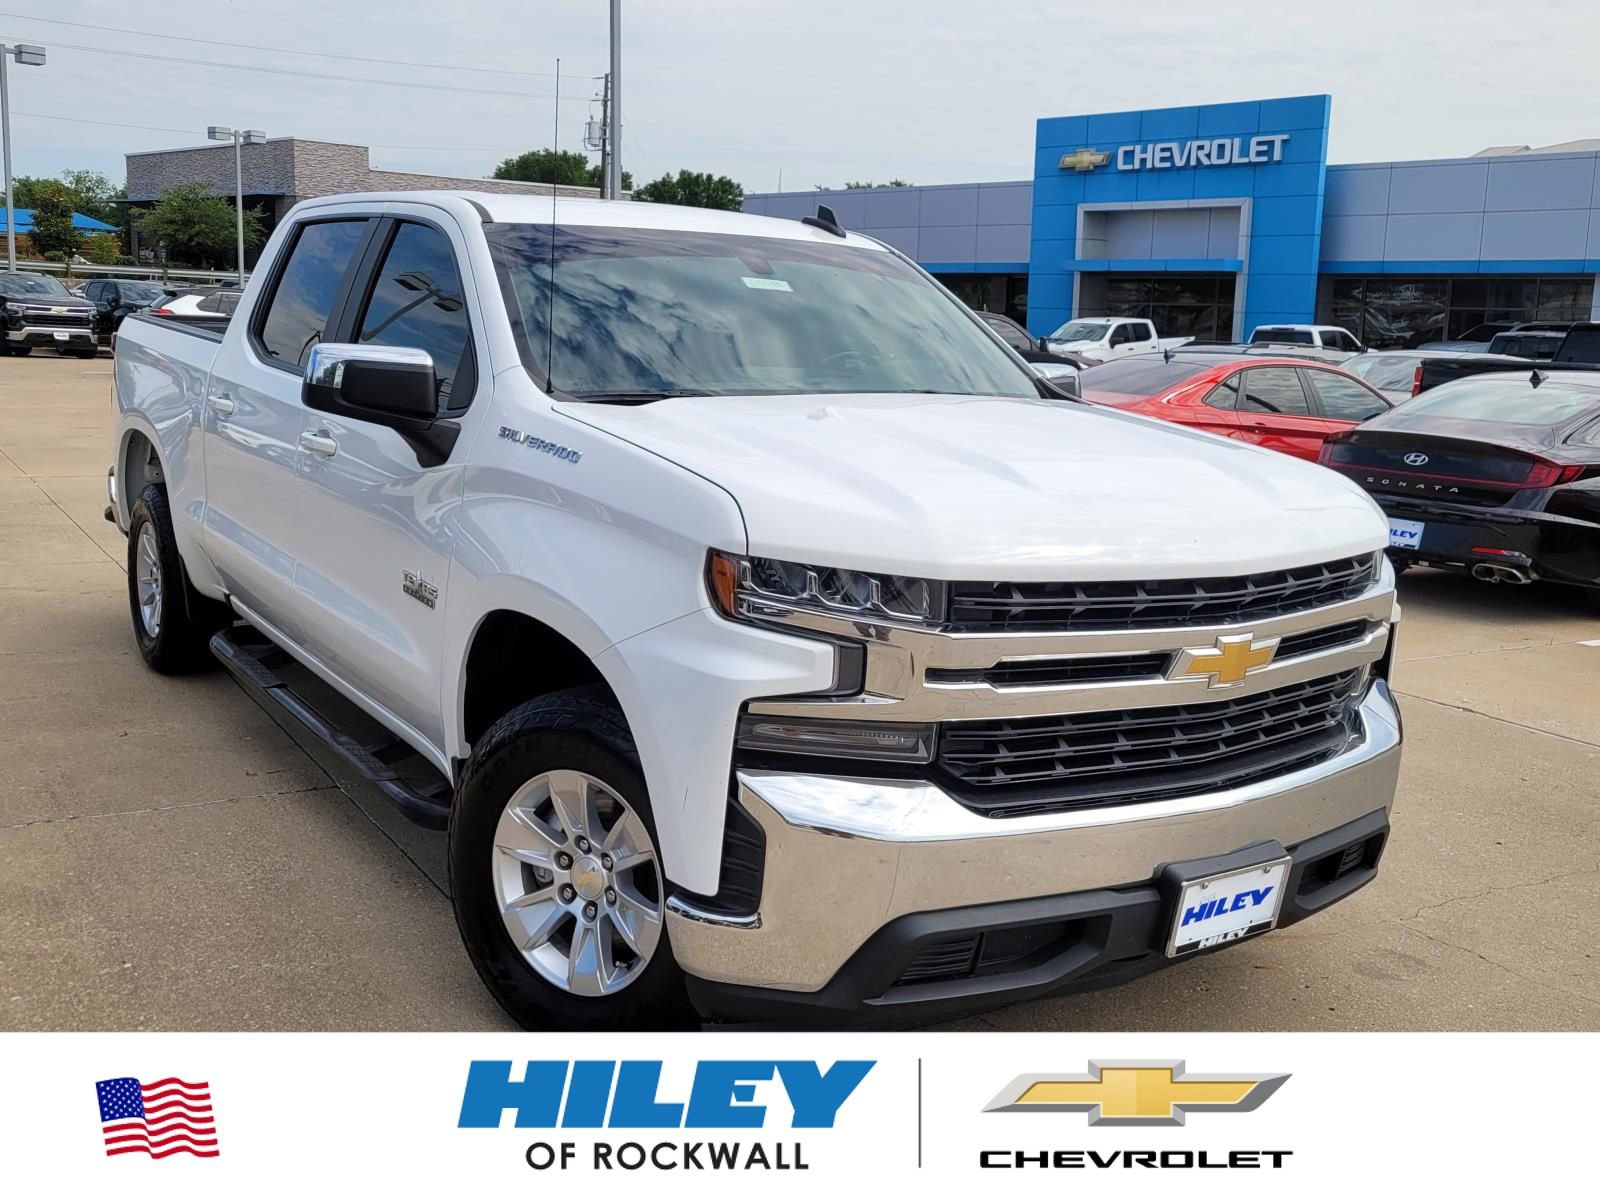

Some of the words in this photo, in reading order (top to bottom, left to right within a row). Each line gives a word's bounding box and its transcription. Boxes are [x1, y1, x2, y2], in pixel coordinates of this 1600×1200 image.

[1117, 134, 1290, 171] CHEVROLET
[498, 425, 583, 464] SILVERADO
[1366, 477, 1459, 493] SONATA
[1180, 886, 1274, 928] HILEY
